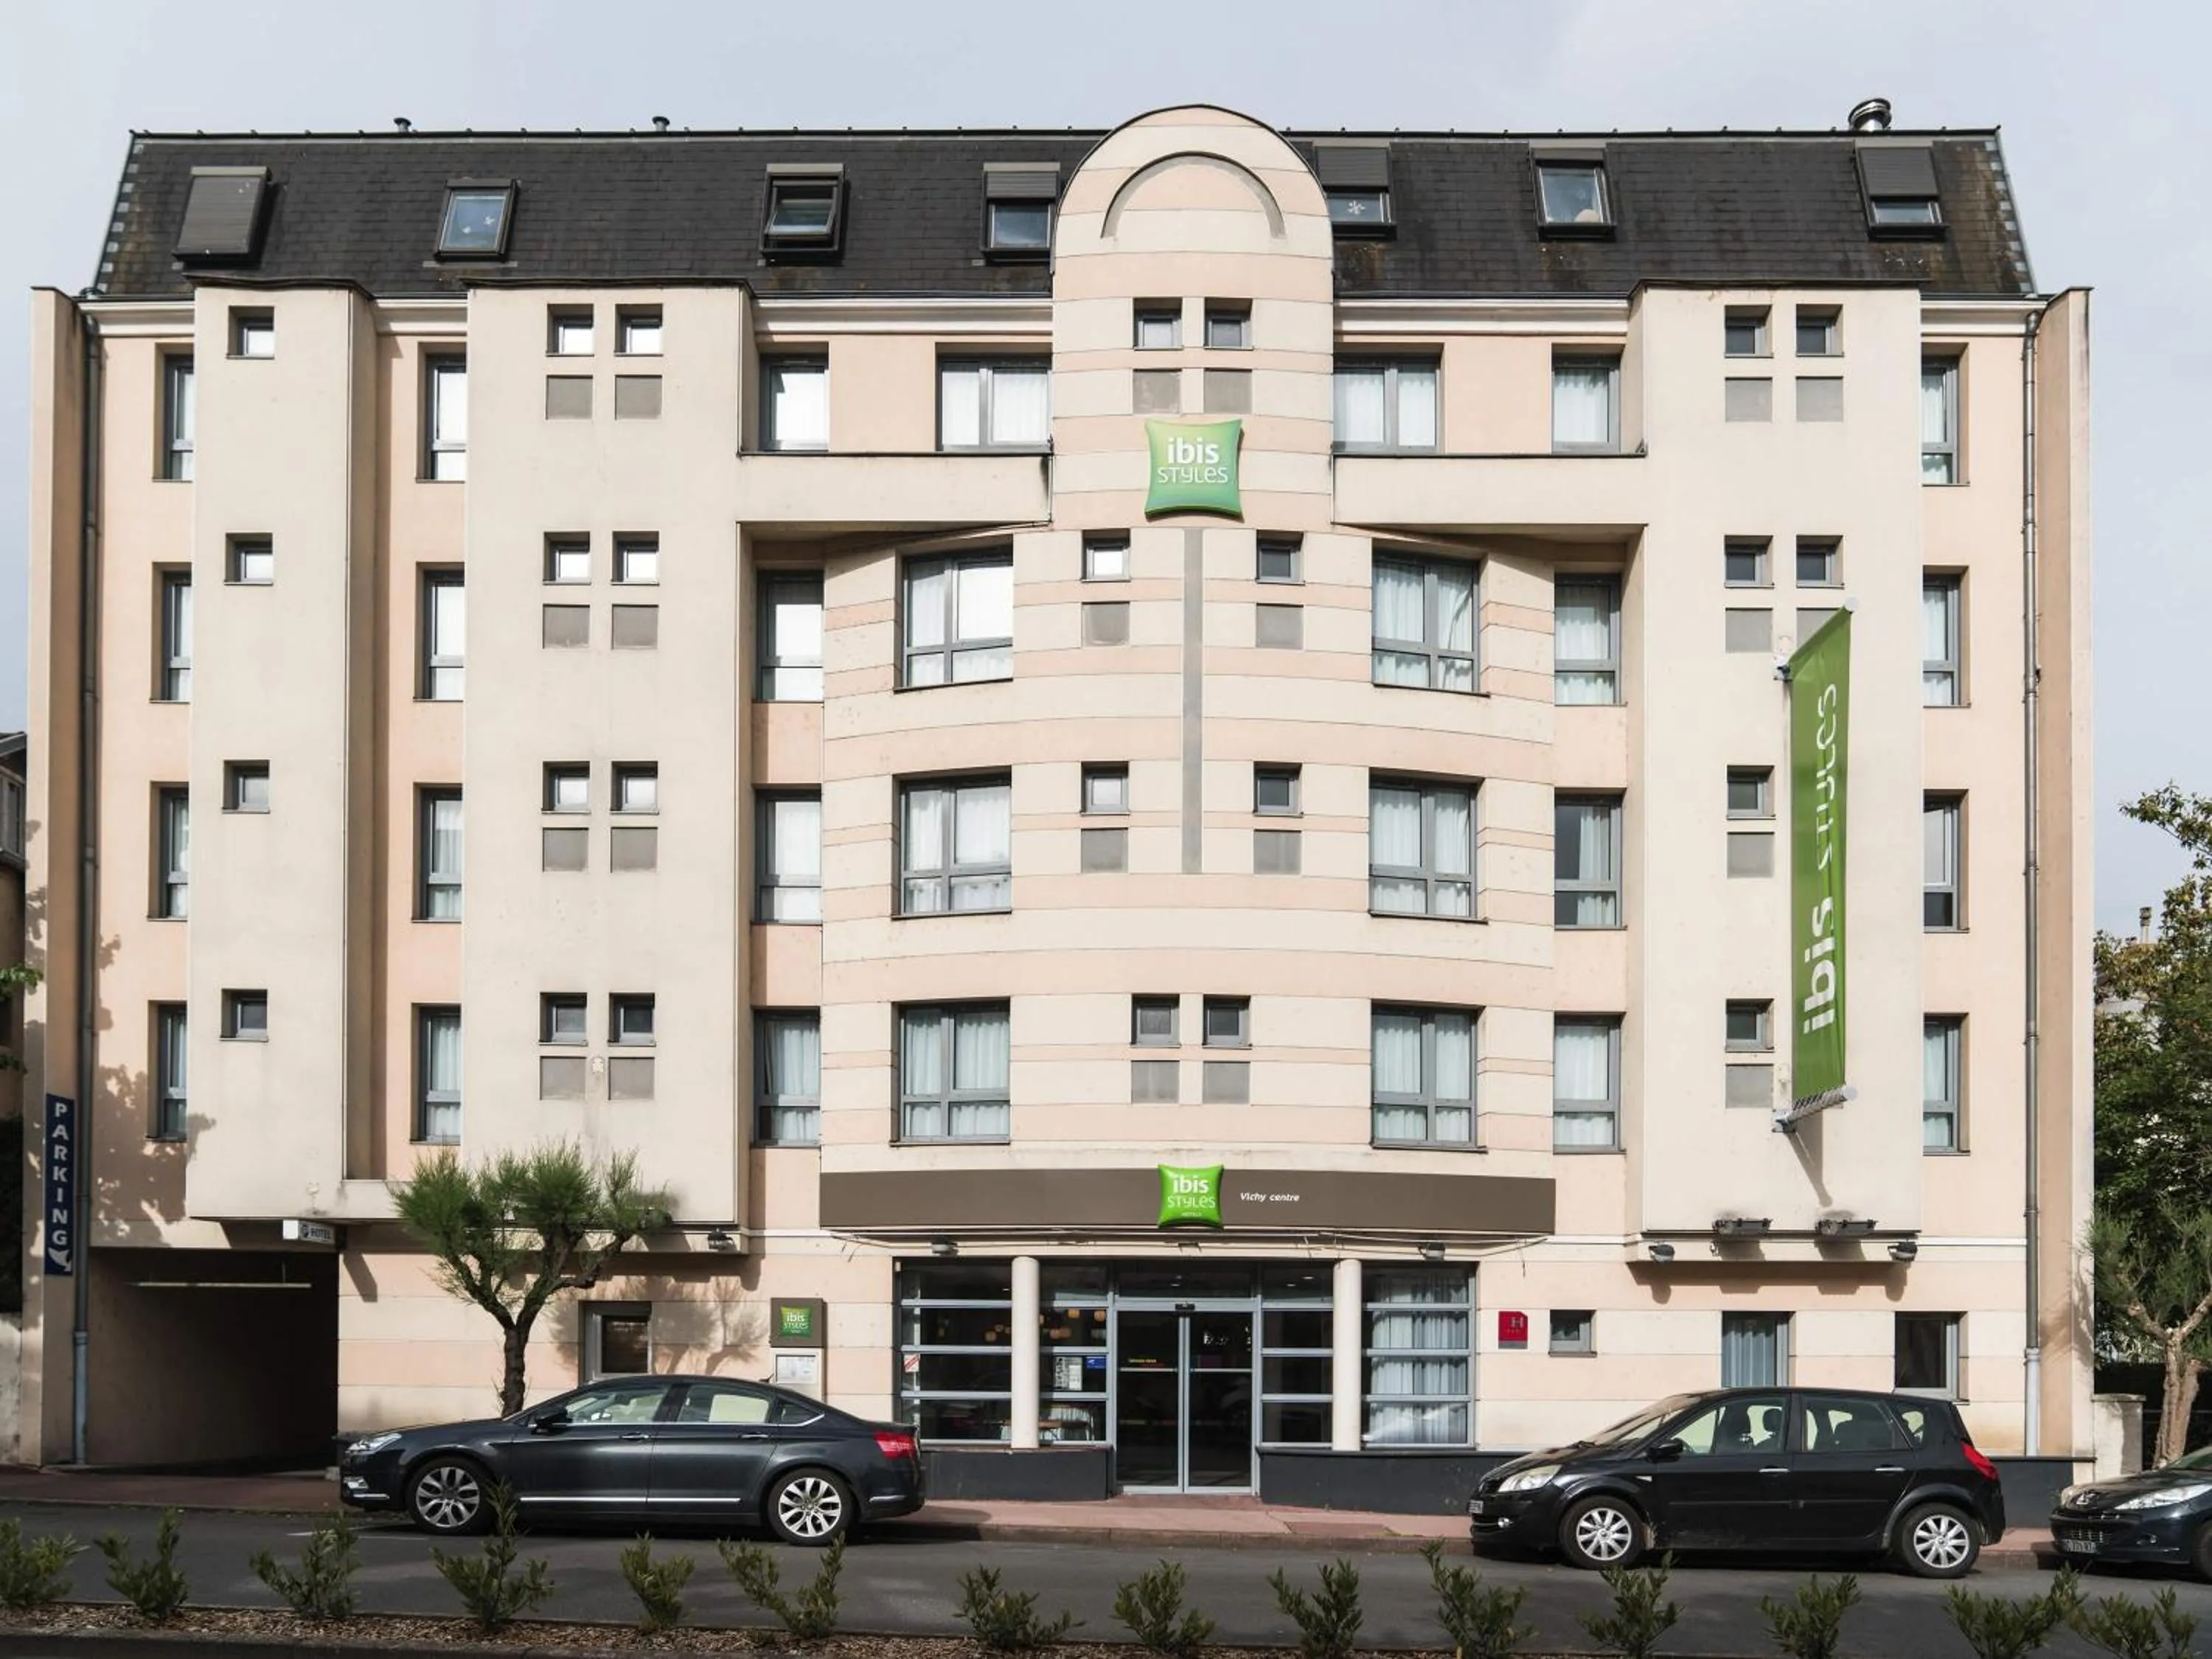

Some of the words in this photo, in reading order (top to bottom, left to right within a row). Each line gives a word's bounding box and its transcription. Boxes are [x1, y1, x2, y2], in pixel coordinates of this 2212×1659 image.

[1167, 437, 1220, 464] ibis
[1804, 897, 1836, 1034] ibis
[52, 1102, 69, 1245] PARKING
[1172, 1175, 1209, 1193] ibis
[1240, 1192, 1266, 1203] Vichy
[787, 1312, 805, 1322] ibis
